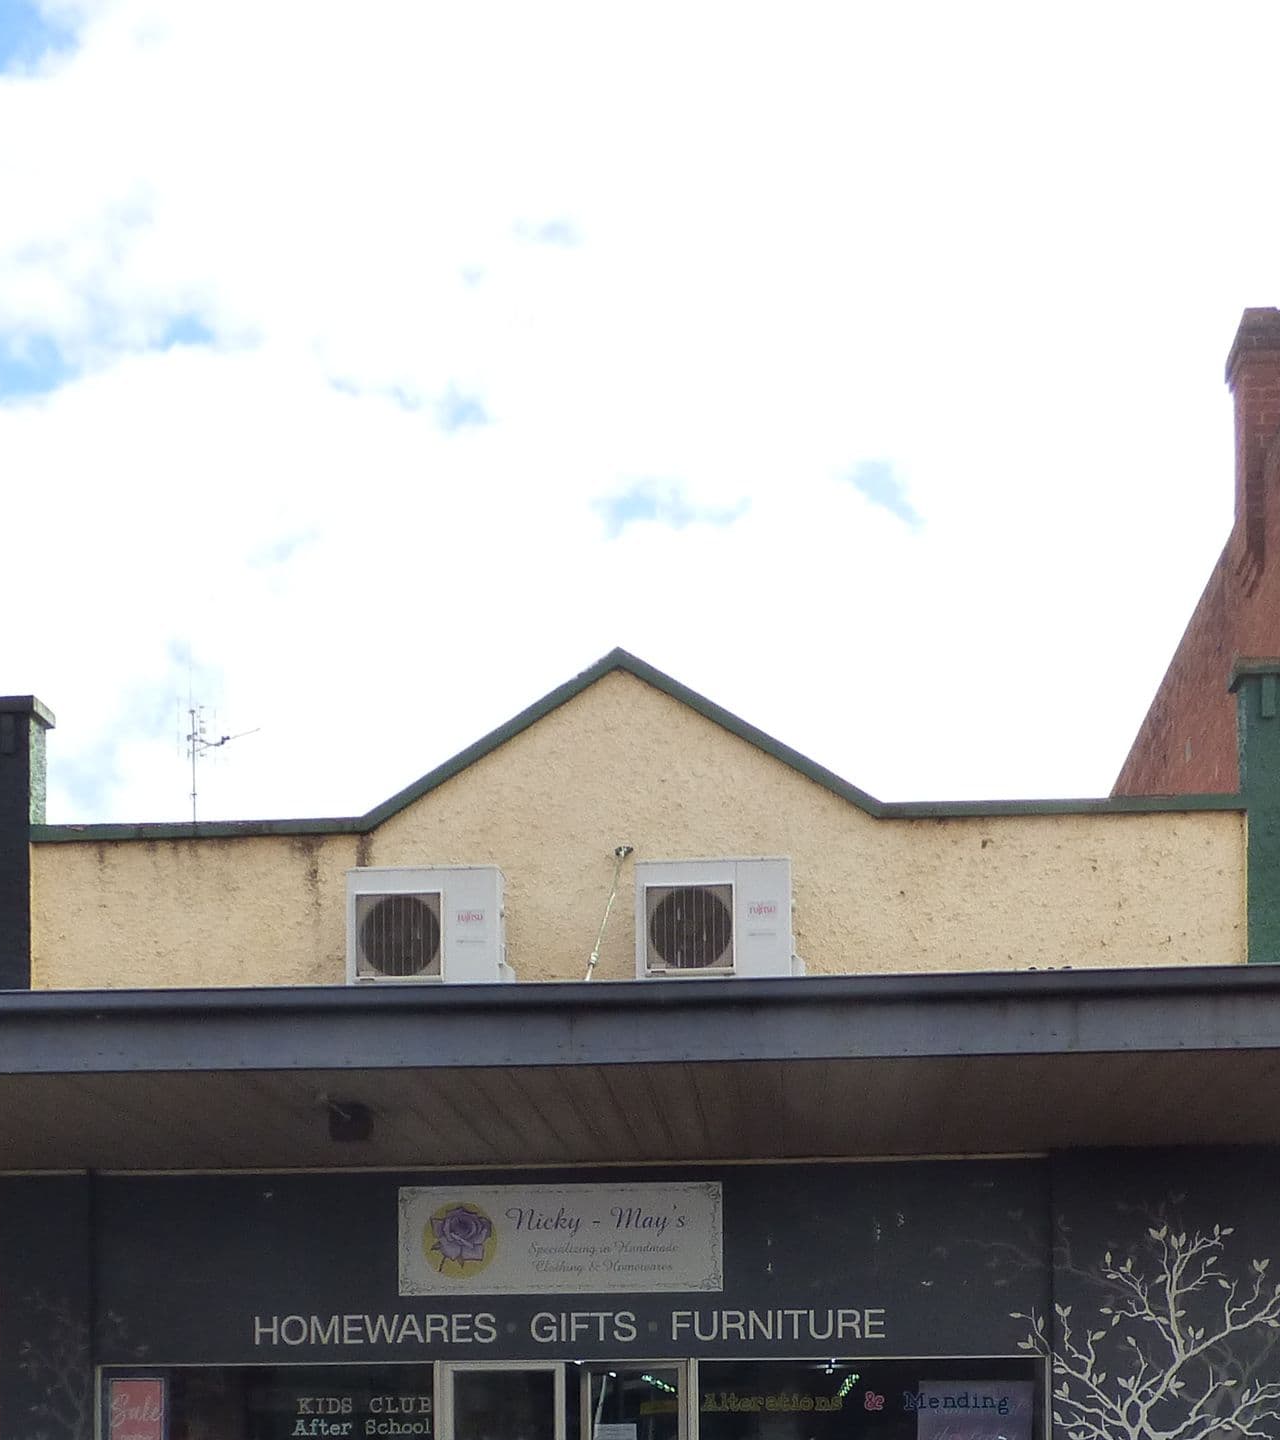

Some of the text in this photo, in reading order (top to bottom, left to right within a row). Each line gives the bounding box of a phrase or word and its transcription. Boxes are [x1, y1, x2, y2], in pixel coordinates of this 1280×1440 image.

[505, 1207, 581, 1237] Nicky
[610, 1205, 686, 1236] May's
[254, 1308, 886, 1346] HOMEWARES GIFTS FURNITURE
[296, 1396, 432, 1415] KIDS CLUB
[863, 1392, 885, 1412] &
[904, 1392, 1009, 1415] Mending
[291, 1418, 431, 1437] After School
